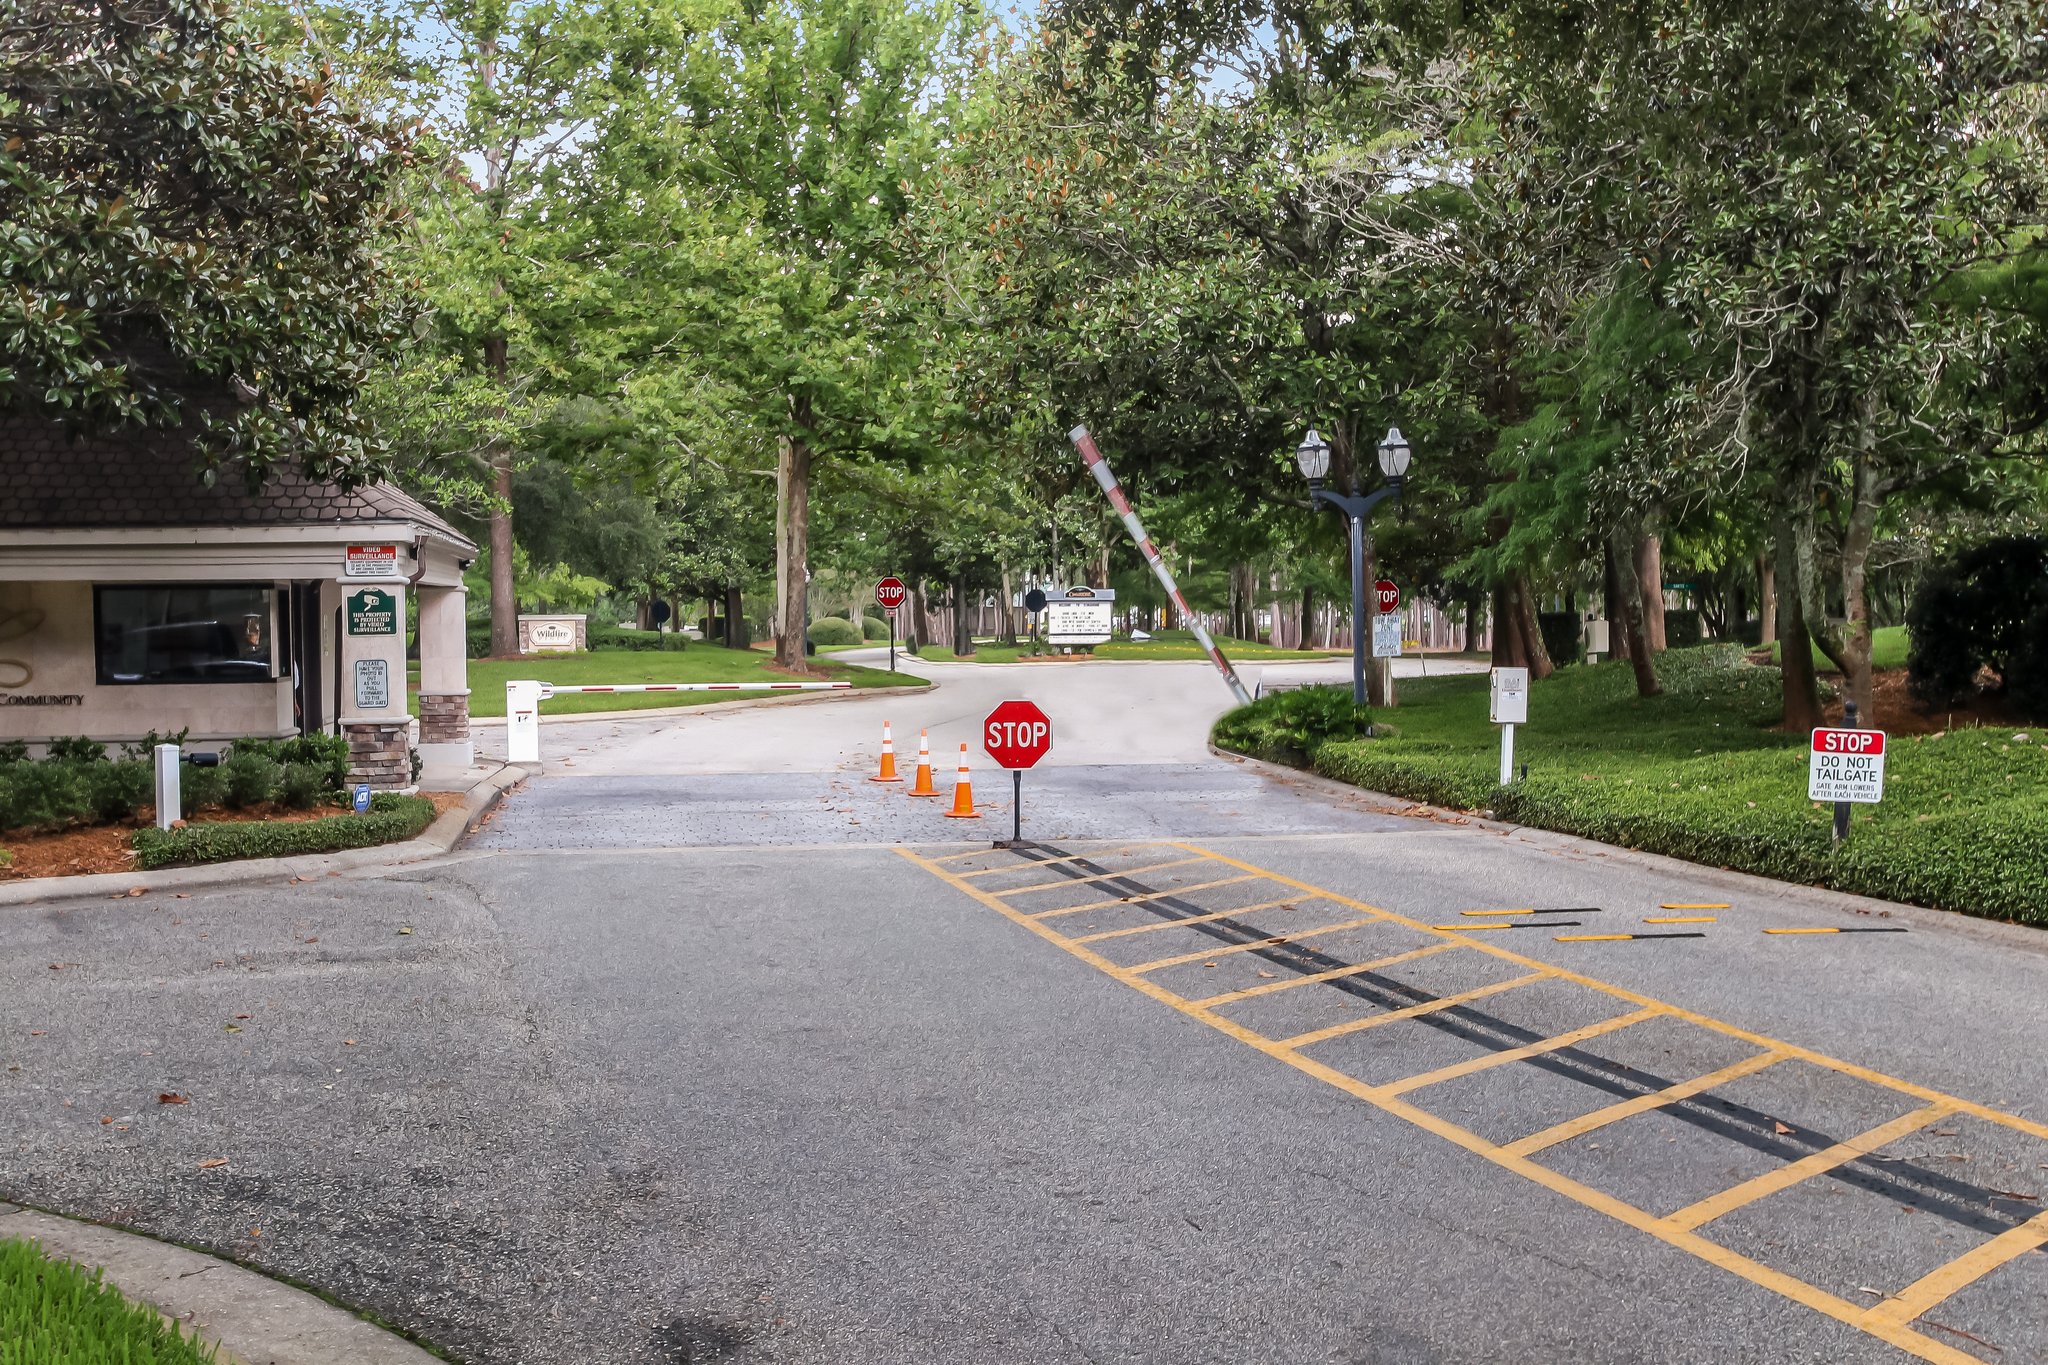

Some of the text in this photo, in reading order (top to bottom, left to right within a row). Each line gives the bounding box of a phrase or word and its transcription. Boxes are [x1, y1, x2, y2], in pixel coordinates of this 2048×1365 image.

[879, 587, 902, 598] STOP
[1377, 591, 1397, 602] TOP
[988, 722, 1046, 748] STOP
[1825, 732, 1872, 752] STOP
[1821, 756, 1872, 768] DO NOT
[1816, 768, 1877, 782] TAILGATE
[1812, 790, 1831, 798] AFTER
